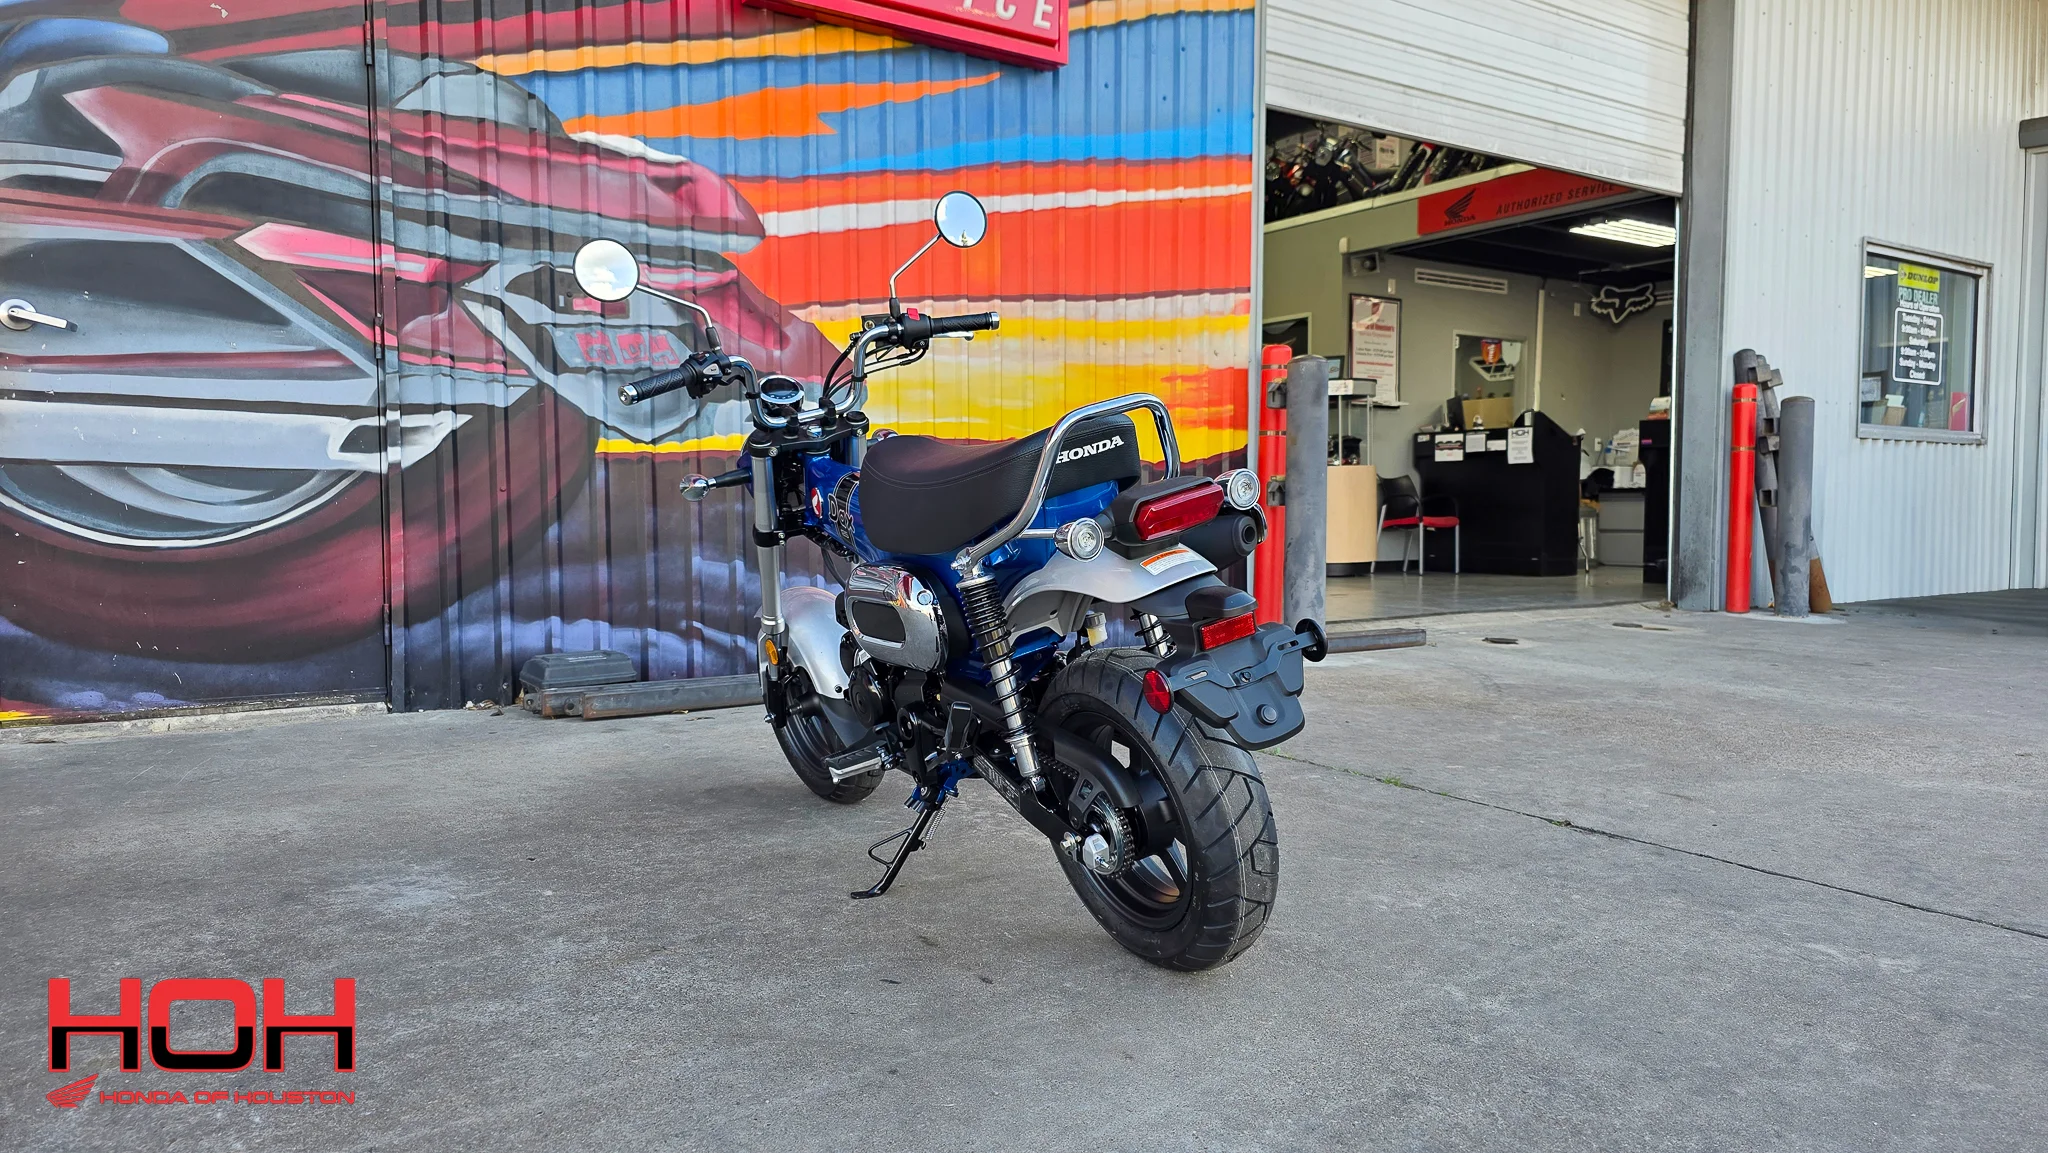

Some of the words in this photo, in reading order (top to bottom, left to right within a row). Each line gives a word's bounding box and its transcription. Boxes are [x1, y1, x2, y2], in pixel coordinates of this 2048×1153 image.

[963, 0, 1054, 30] CE
[1496, 192, 1562, 215] AUTHORIZED
[1443, 214, 1476, 227] HONDA
[1907, 272, 1939, 284] DUNLOP
[1899, 286, 1913, 302] PRO
[1913, 289, 1938, 306] DEALER
[1902, 312, 1920, 326] Tuesday
[1923, 315, 1937, 329] Friday
[1056, 435, 1125, 464] HONDA
